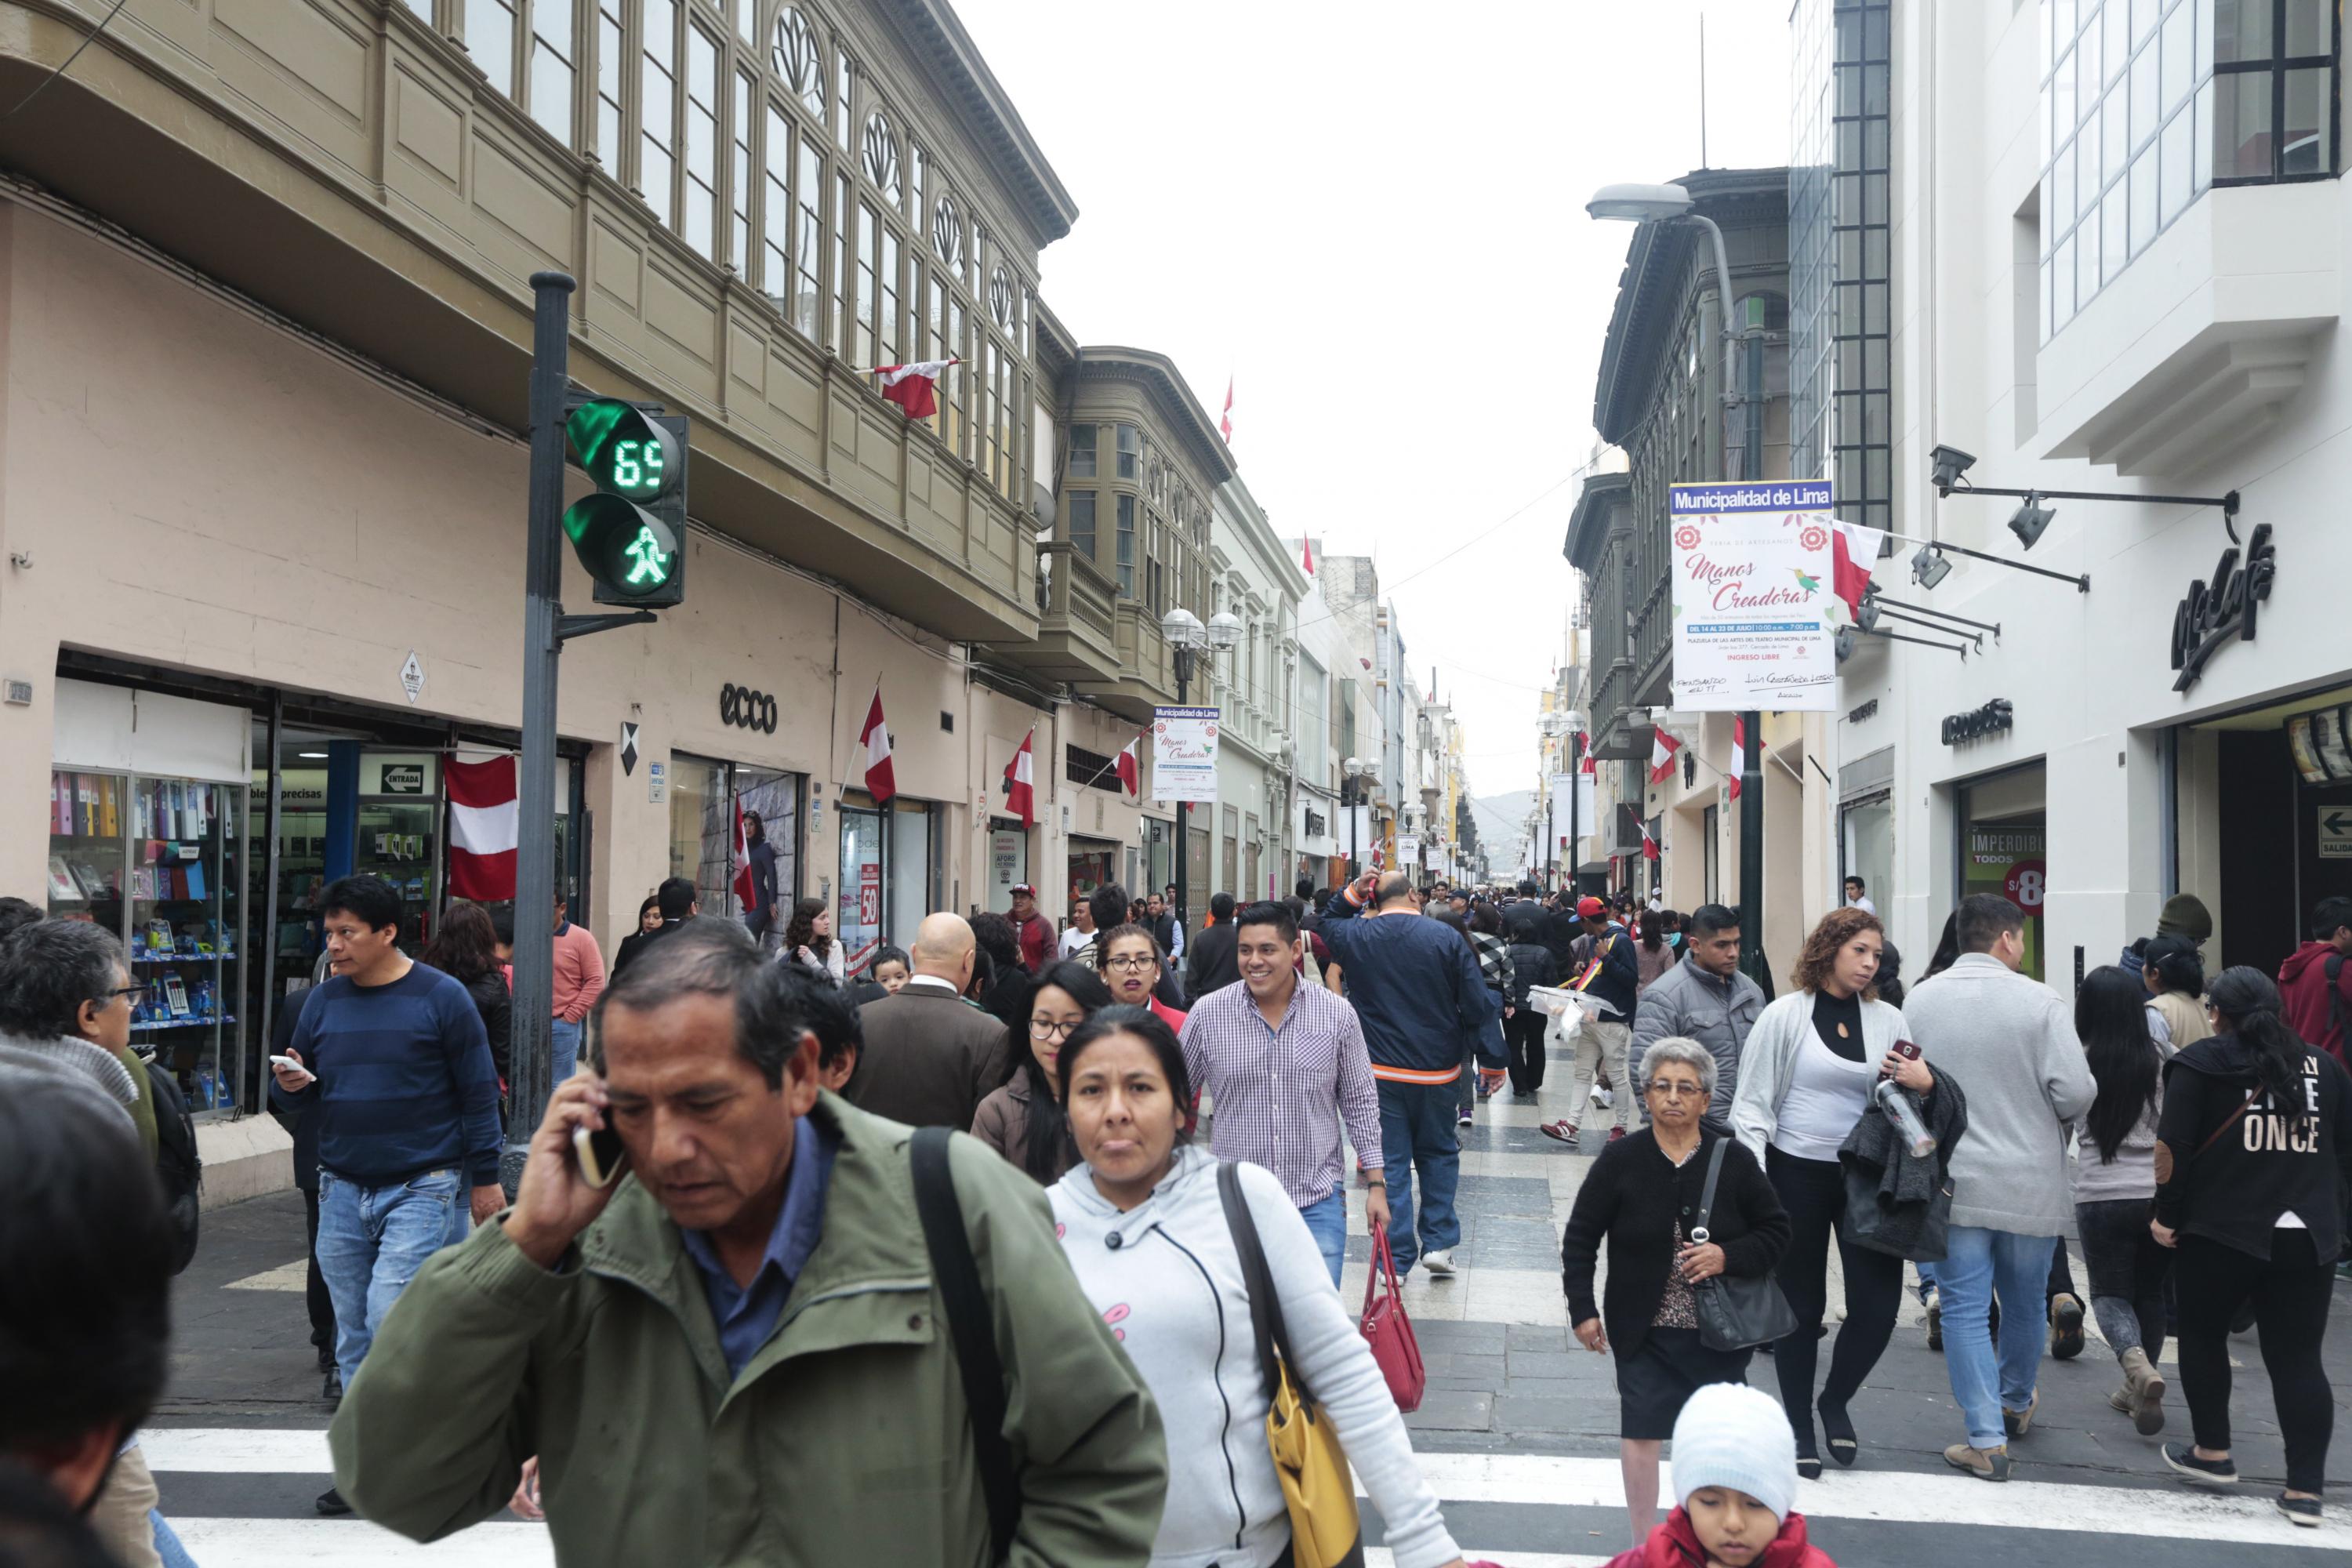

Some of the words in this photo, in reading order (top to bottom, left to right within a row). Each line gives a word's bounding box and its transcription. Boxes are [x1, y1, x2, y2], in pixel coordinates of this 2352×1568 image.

[1675, 489, 1771, 511] Municipalidad
[1773, 489, 1791, 506] de
[1794, 488, 1829, 505] Lima
[1686, 553, 1756, 590] Manos
[1712, 580, 1812, 612] Creadoras
[720, 683, 778, 734] ecco
[1156, 708, 1196, 717] Municipalidad
[1159, 735, 1186, 748] Manos
[389, 774, 419, 783] ENTRADA
[281, 787, 322, 800] precisas
[1973, 834, 2045, 852] IMPERDIBL
[862, 888, 877, 924] 50
[2244, 1115, 2321, 1153] ONCE
